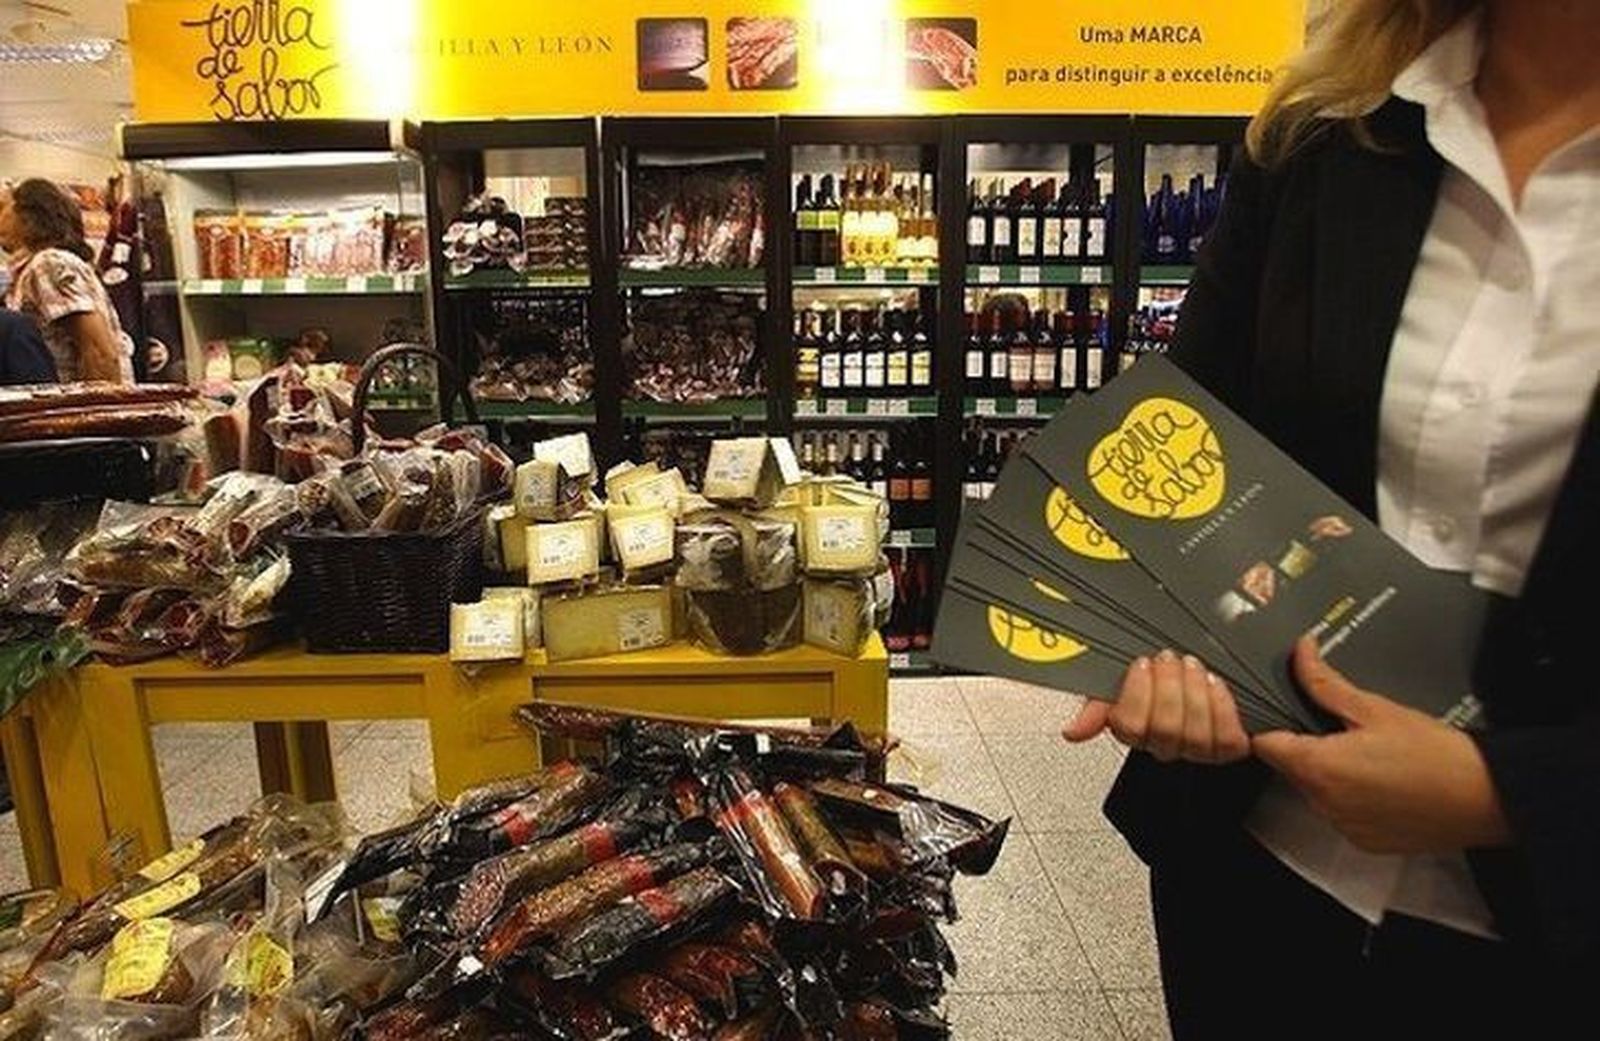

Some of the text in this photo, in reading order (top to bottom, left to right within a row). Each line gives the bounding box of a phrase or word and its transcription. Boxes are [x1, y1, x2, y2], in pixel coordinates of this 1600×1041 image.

[181, 0, 334, 50] tierra
[1080, 26, 1202, 43] Uma MARCA
[197, 50, 243, 79] de
[211, 48, 340, 121] sabor
[1006, 68, 1049, 85] para
[1055, 65, 1150, 86] distinguir
[1155, 69, 1165, 82] a
[1089, 411, 1198, 480] tierra
[1147, 430, 1223, 517] sabor
